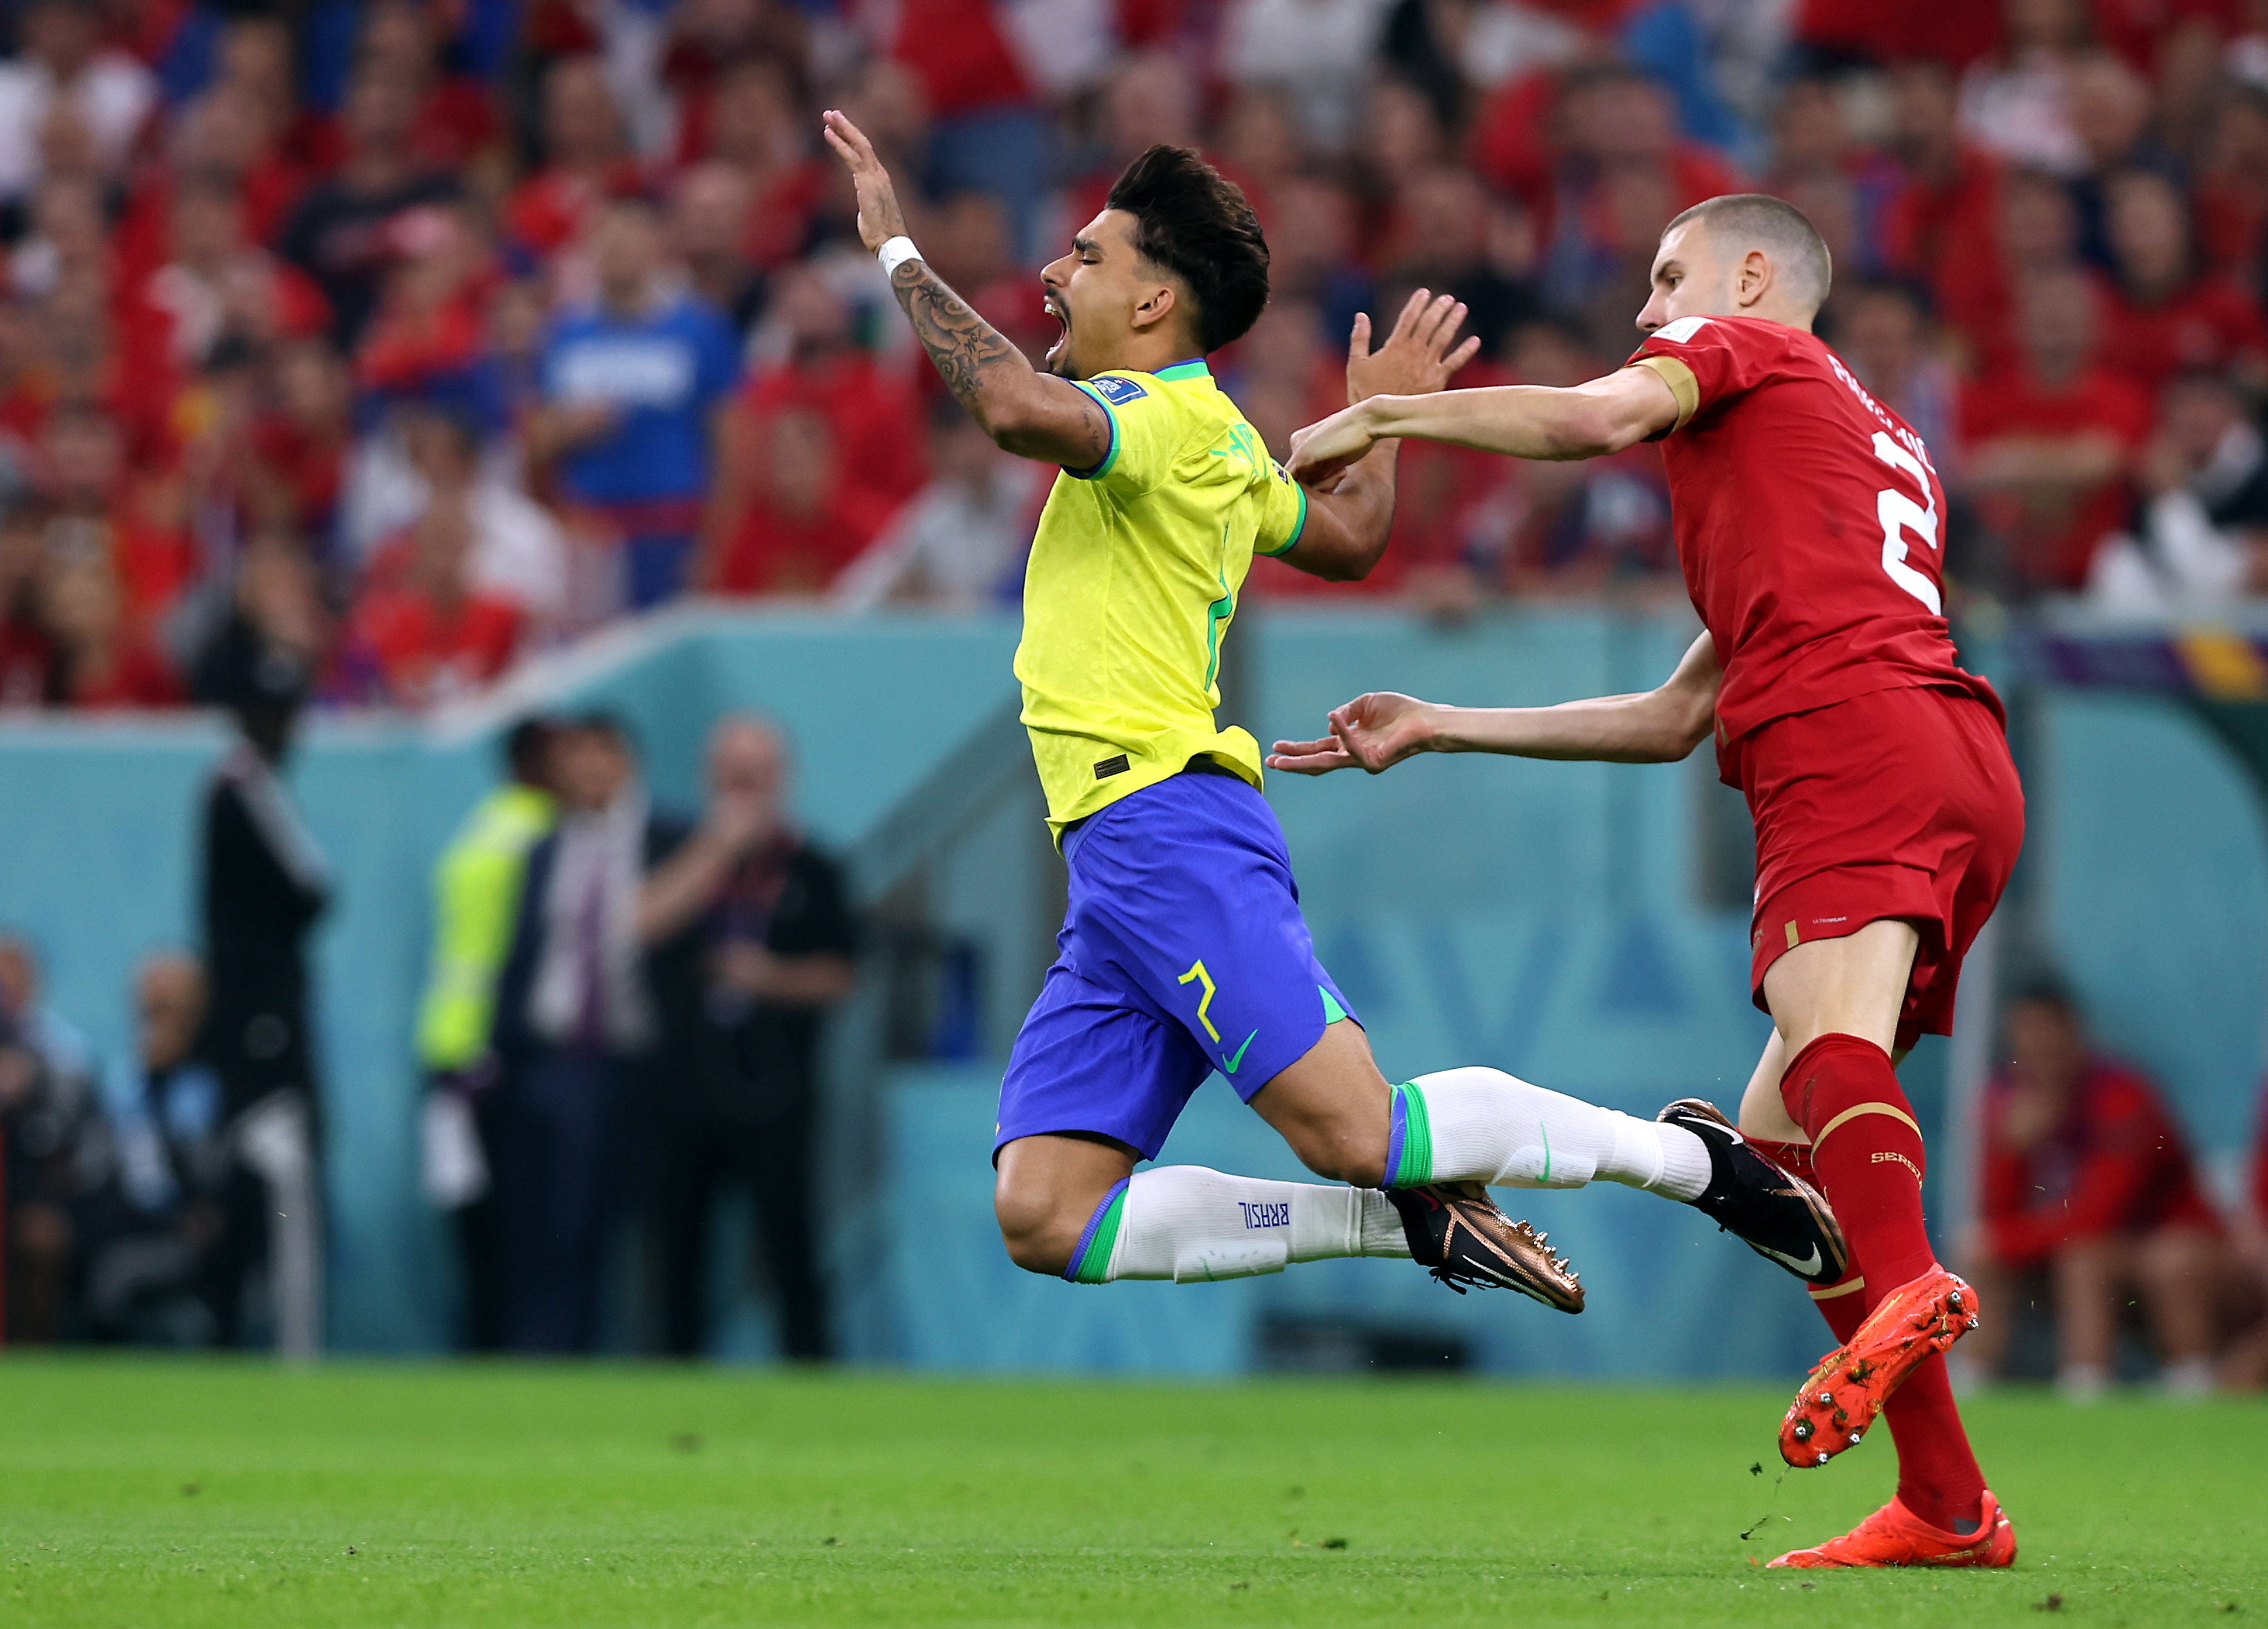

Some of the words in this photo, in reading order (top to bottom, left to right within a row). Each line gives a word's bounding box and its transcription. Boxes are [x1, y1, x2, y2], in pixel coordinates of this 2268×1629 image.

[1871, 430, 1941, 616] 2
[1178, 959, 1221, 1044] 7
[1238, 1202, 1290, 1229] BRASIL
